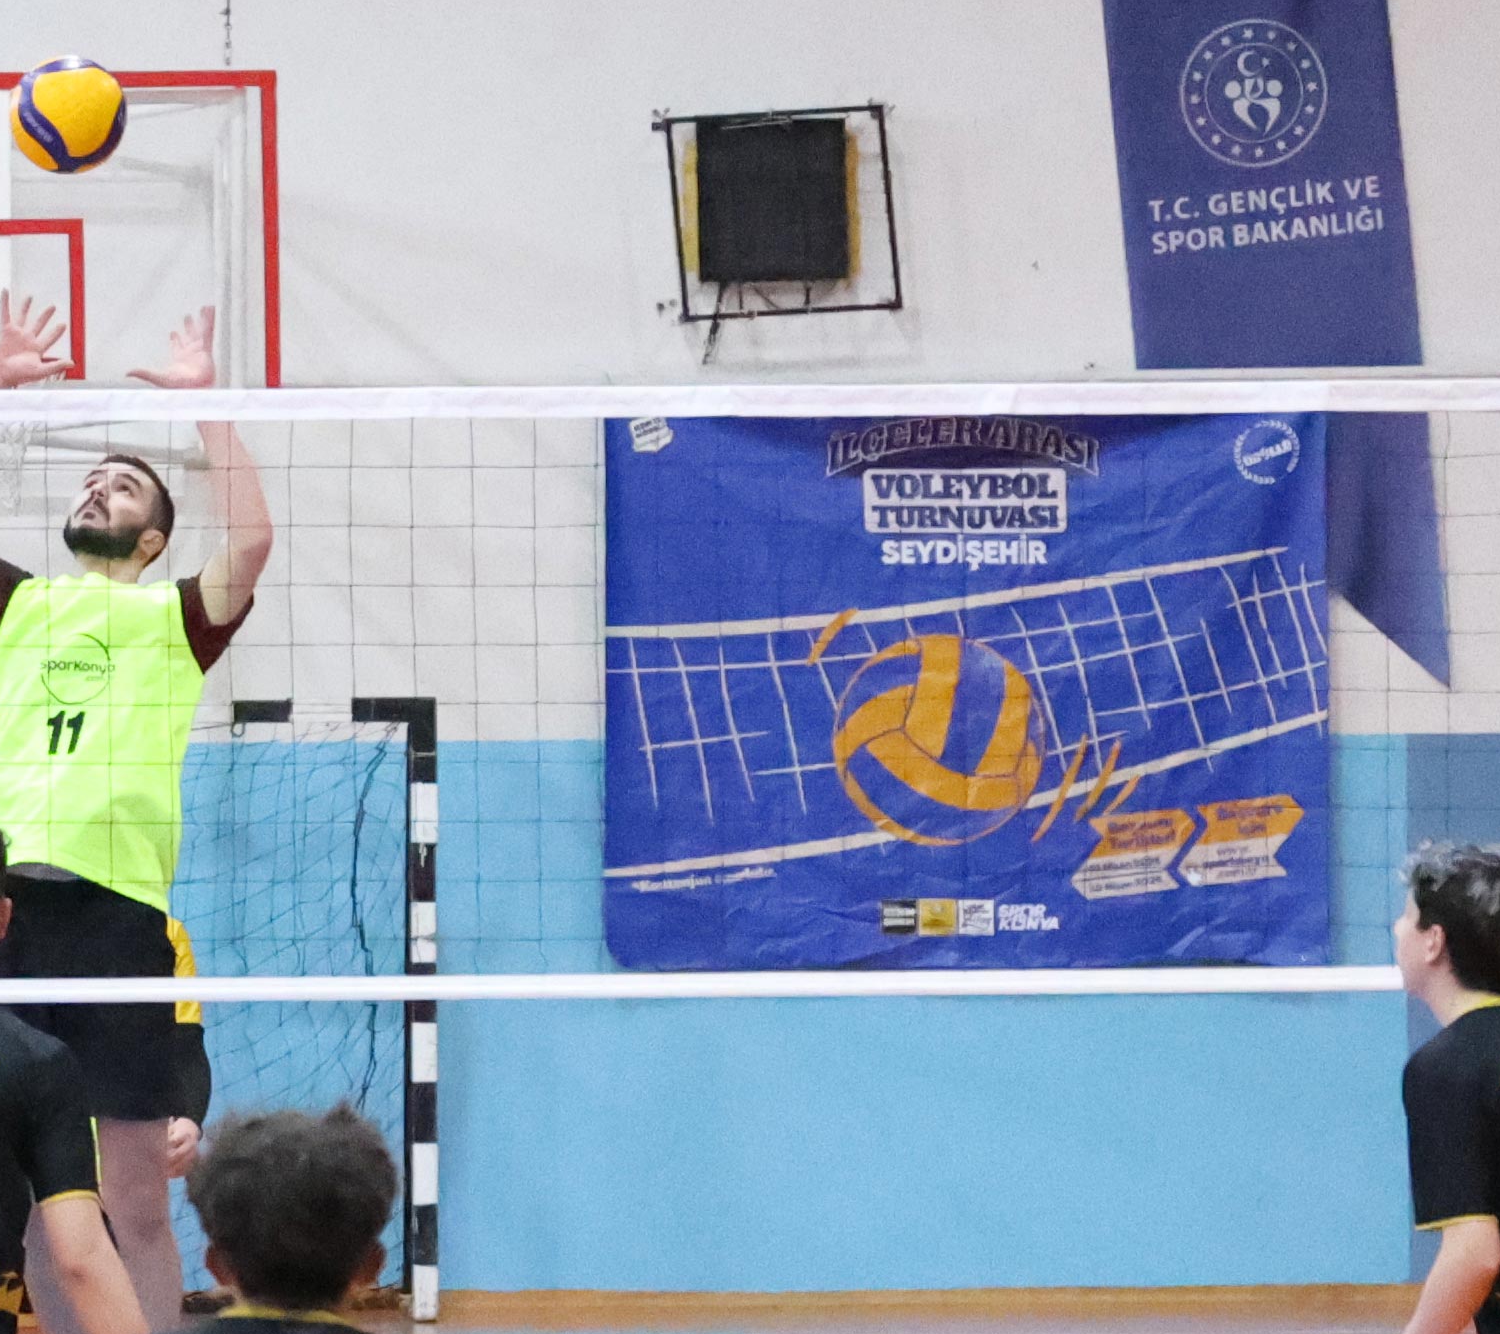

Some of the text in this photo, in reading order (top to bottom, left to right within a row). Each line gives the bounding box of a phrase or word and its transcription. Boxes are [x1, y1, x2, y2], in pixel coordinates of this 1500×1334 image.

[1149, 175, 1381, 222] T.C. GENÇLİK VE
[1152, 205, 1384, 255] SPOR BAKANLIĞI
[871, 474, 1058, 499] VOLEYBOL
[871, 505, 1059, 529] TURNUVASI
[881, 533, 1048, 571] SEYDİŞEHİR
[46, 710, 86, 755] 11
